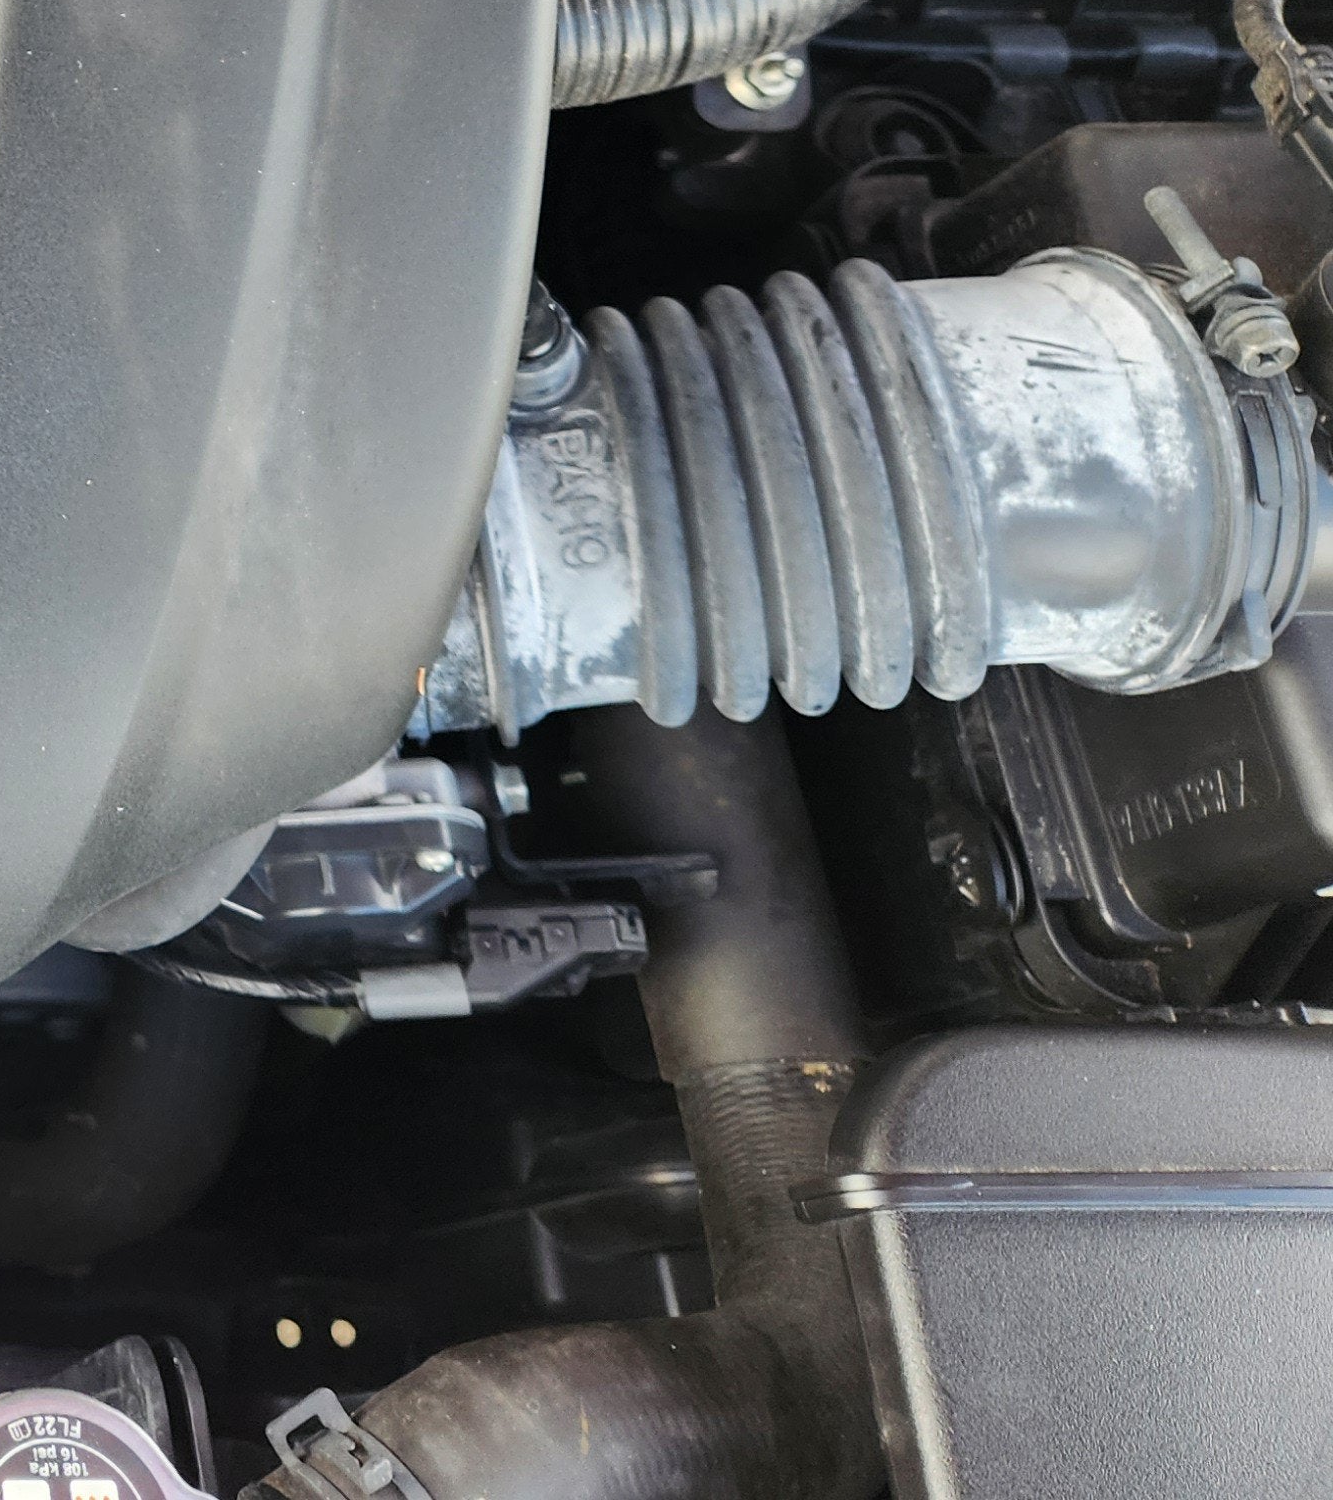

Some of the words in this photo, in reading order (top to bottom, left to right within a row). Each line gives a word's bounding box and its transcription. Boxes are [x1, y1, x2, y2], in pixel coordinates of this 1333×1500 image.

[32, 1415, 82, 1440] FL22
[32, 1444, 58, 1460] psi
[61, 1447, 79, 1462] 16
[29, 1461, 60, 1478] kPa
[63, 1462, 89, 1478] 108
